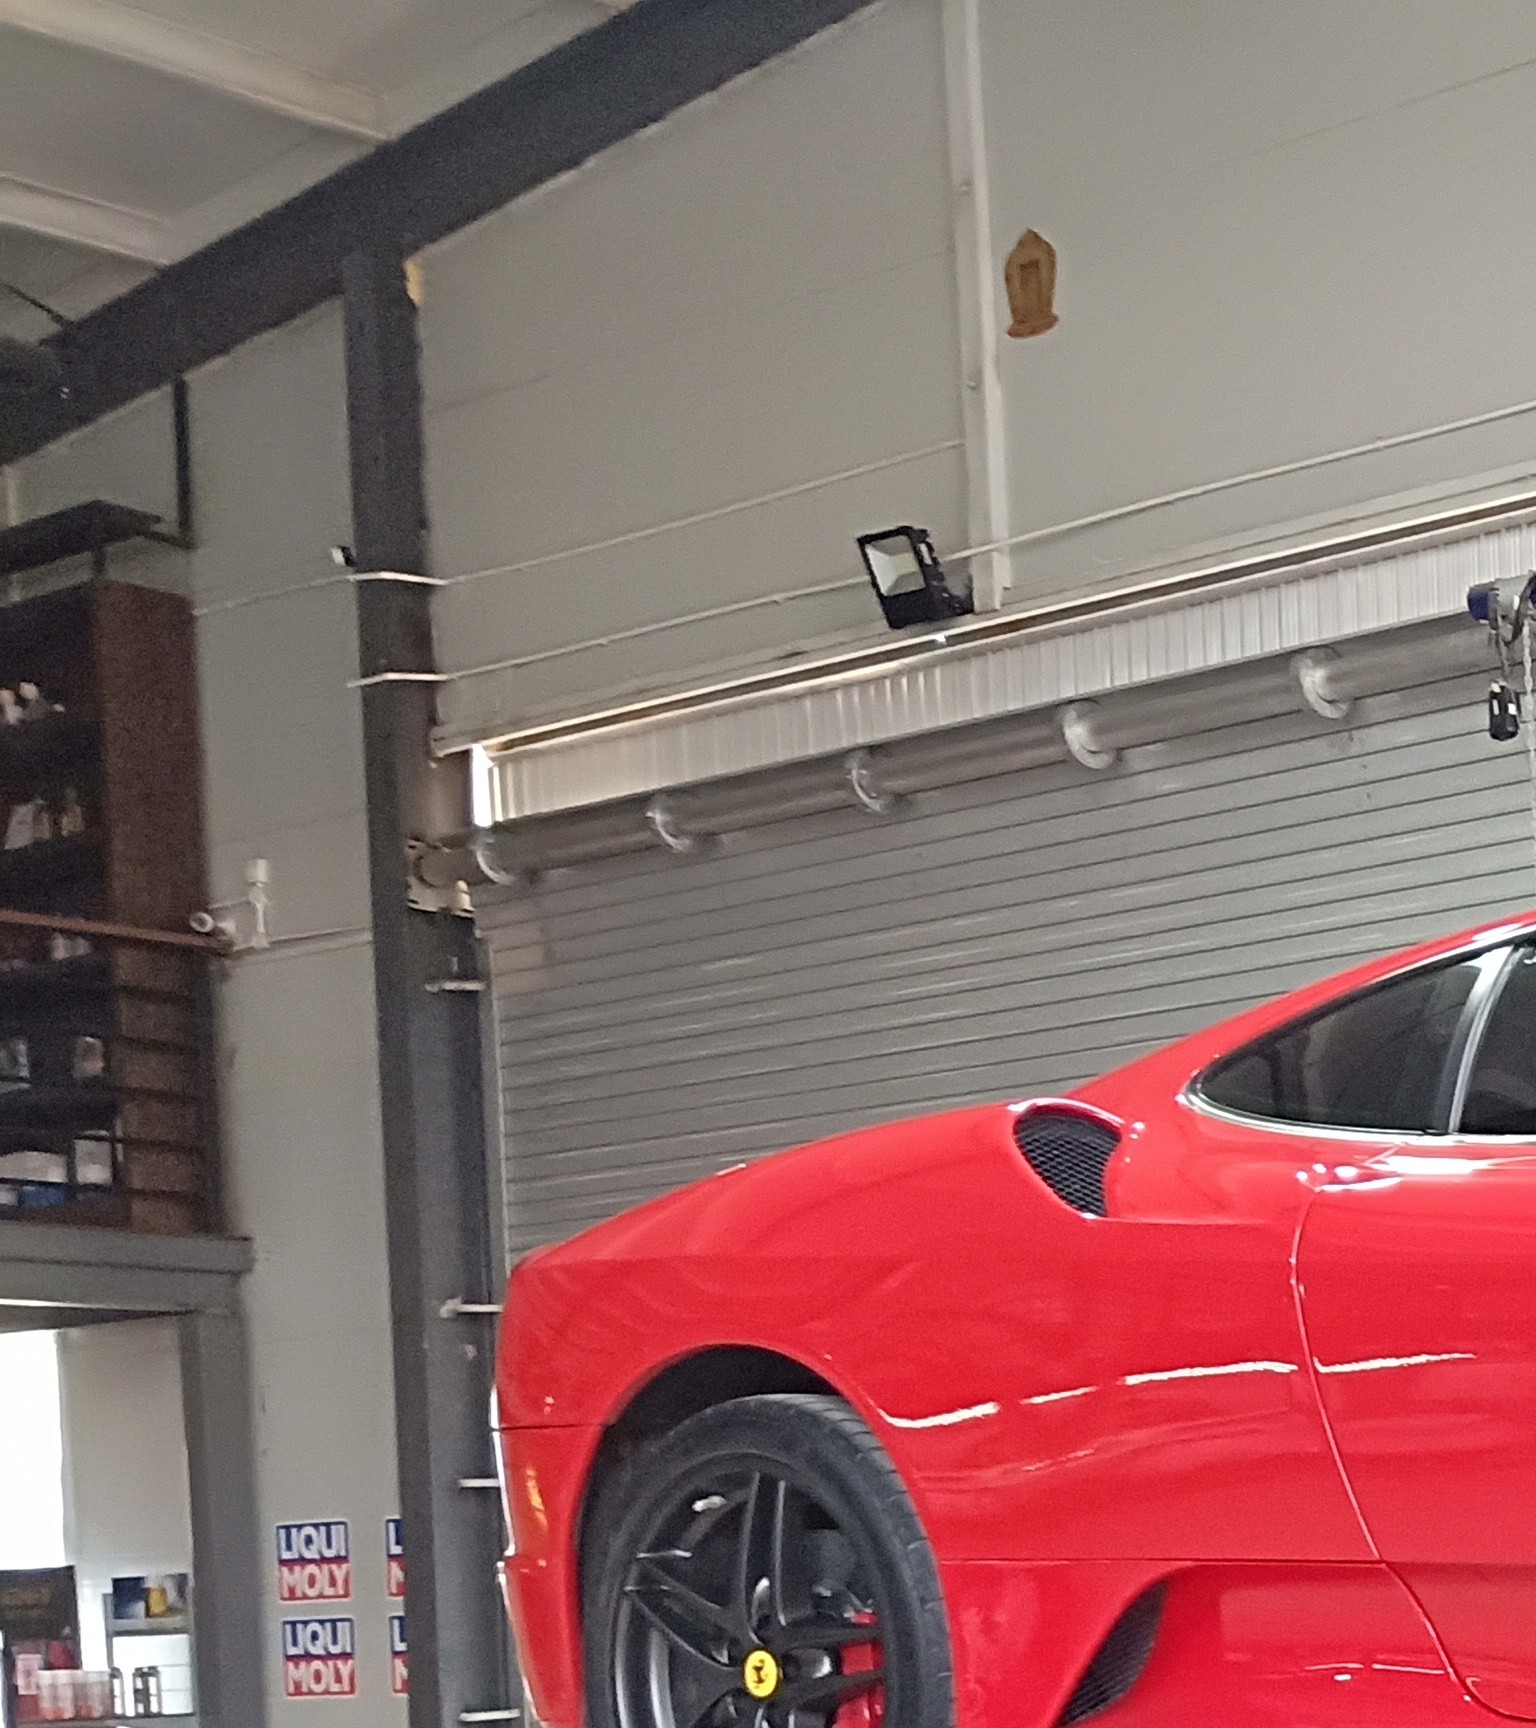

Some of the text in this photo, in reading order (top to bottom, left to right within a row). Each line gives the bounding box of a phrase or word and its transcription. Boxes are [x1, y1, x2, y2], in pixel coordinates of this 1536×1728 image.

[278, 1524, 347, 1561] LIQUI
[280, 1562, 350, 1598] MOLY
[284, 1621, 352, 1656] LIQUI
[286, 1658, 356, 1694] MOLY
